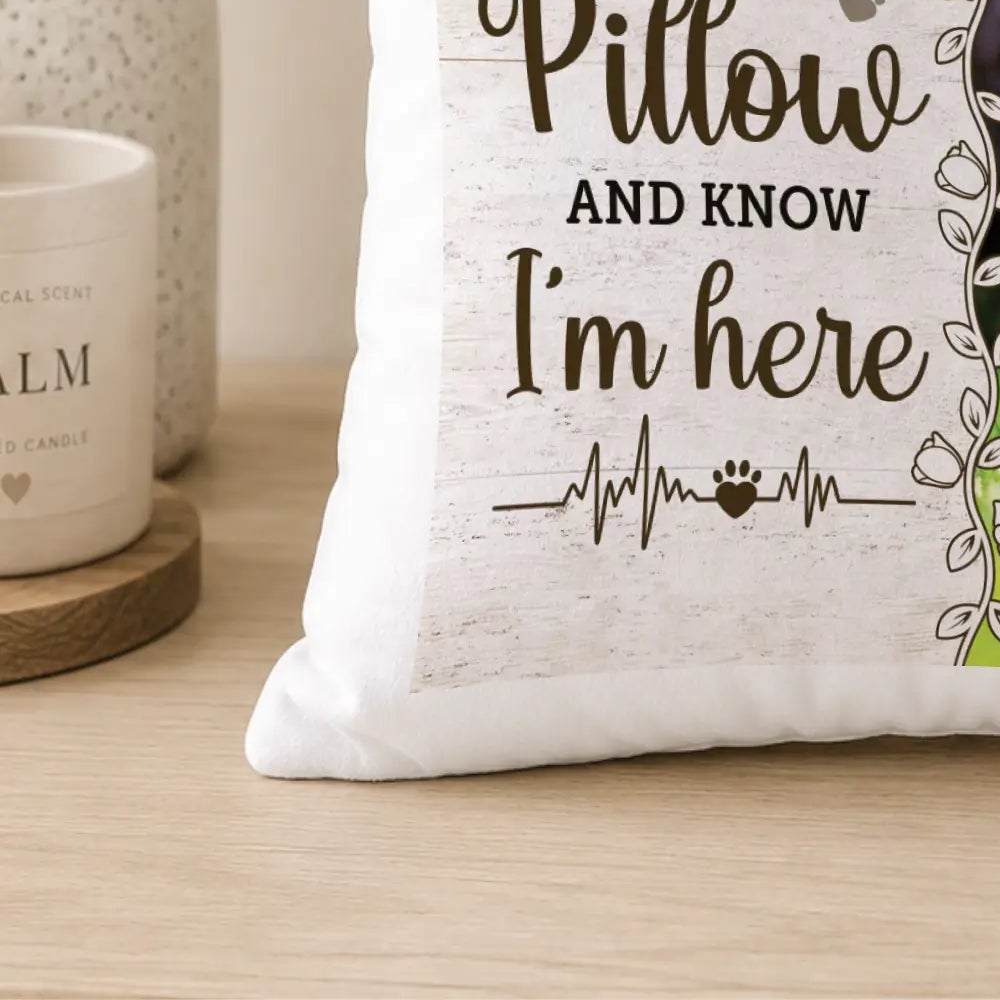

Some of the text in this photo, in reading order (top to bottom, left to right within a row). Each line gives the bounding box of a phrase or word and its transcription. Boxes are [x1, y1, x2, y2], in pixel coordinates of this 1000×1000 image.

[566, 179, 871, 232] AND KNOW
[41, 284, 93, 302] SCENT
[506, 247, 930, 402] I'm here
[23, 428, 88, 453] CANDLE
